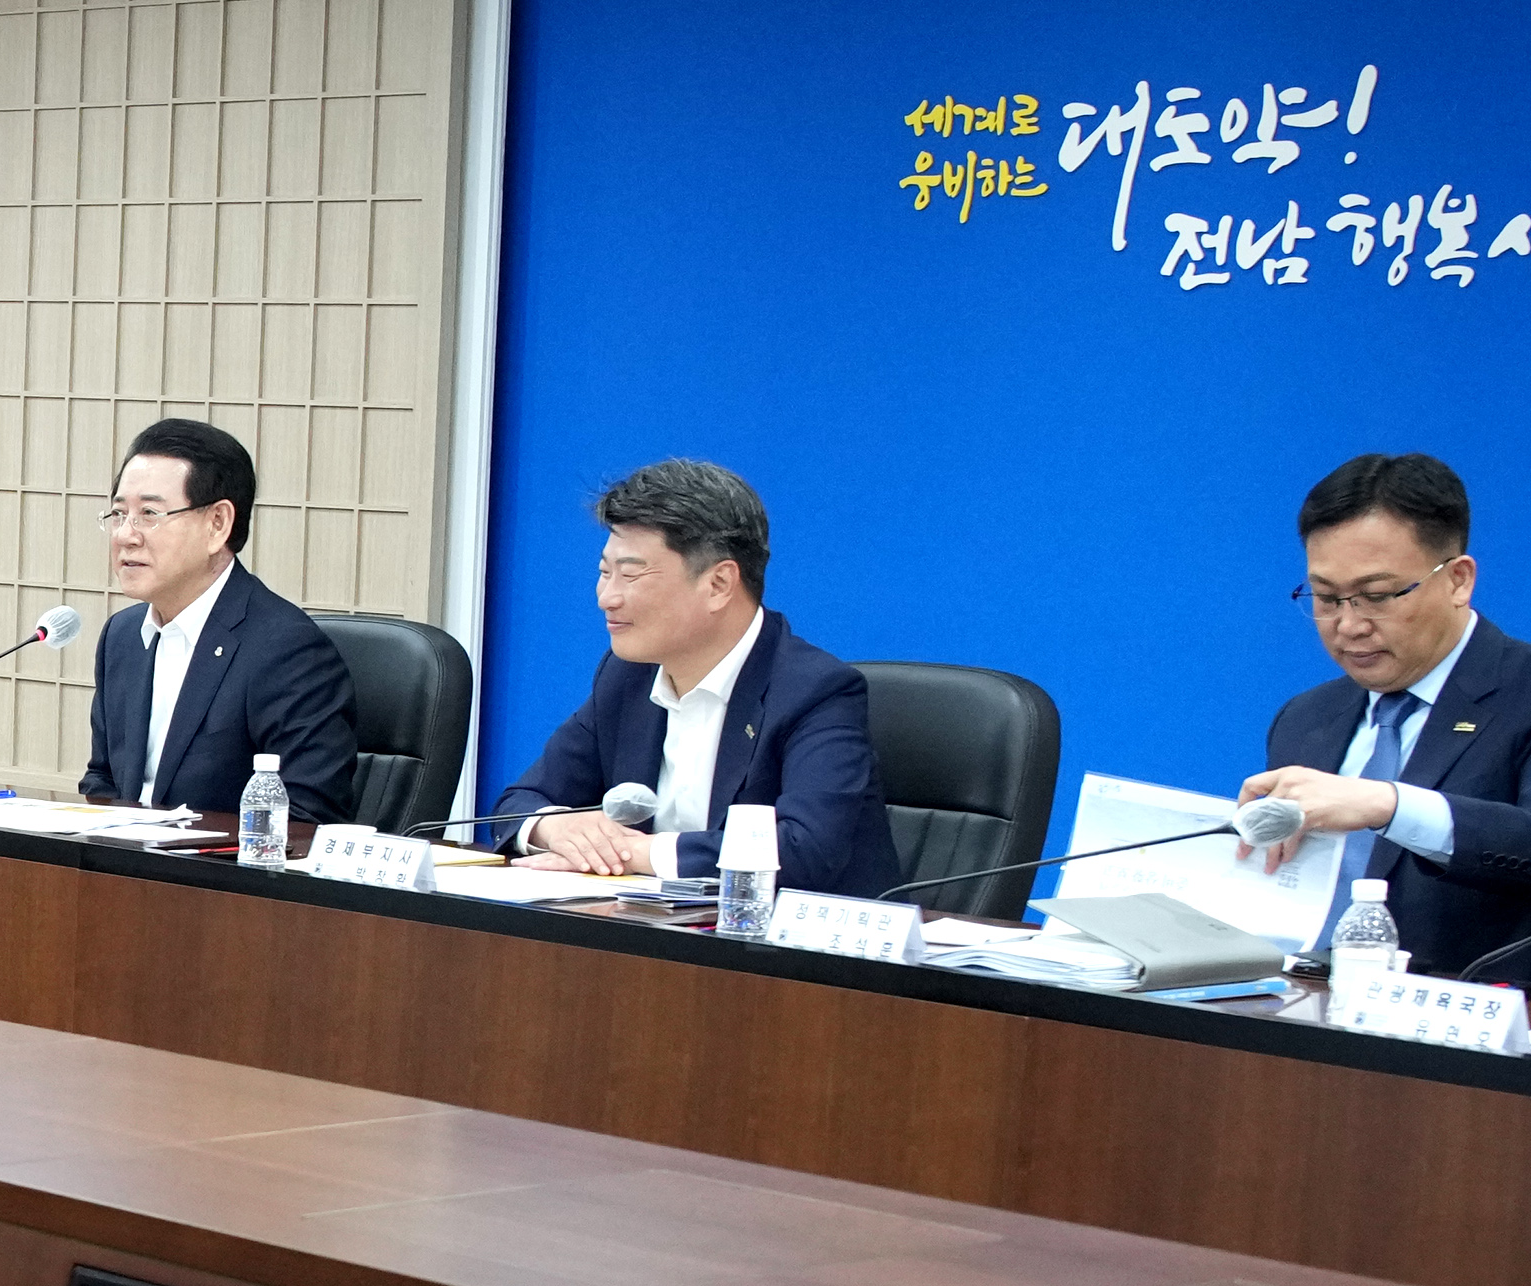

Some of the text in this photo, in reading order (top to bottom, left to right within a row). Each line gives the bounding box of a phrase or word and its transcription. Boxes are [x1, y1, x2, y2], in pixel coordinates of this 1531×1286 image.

[904, 94, 1040, 138] 세계로
[1058, 63, 1378, 252] 대도약!
[899, 150, 1049, 224] 웅비하는
[1159, 198, 1316, 291] 전남
[325, 838, 413, 865] 경제부지사
[795, 903, 892, 931] 정책기획관
[1366, 980, 1502, 1020] 관광체육국장
